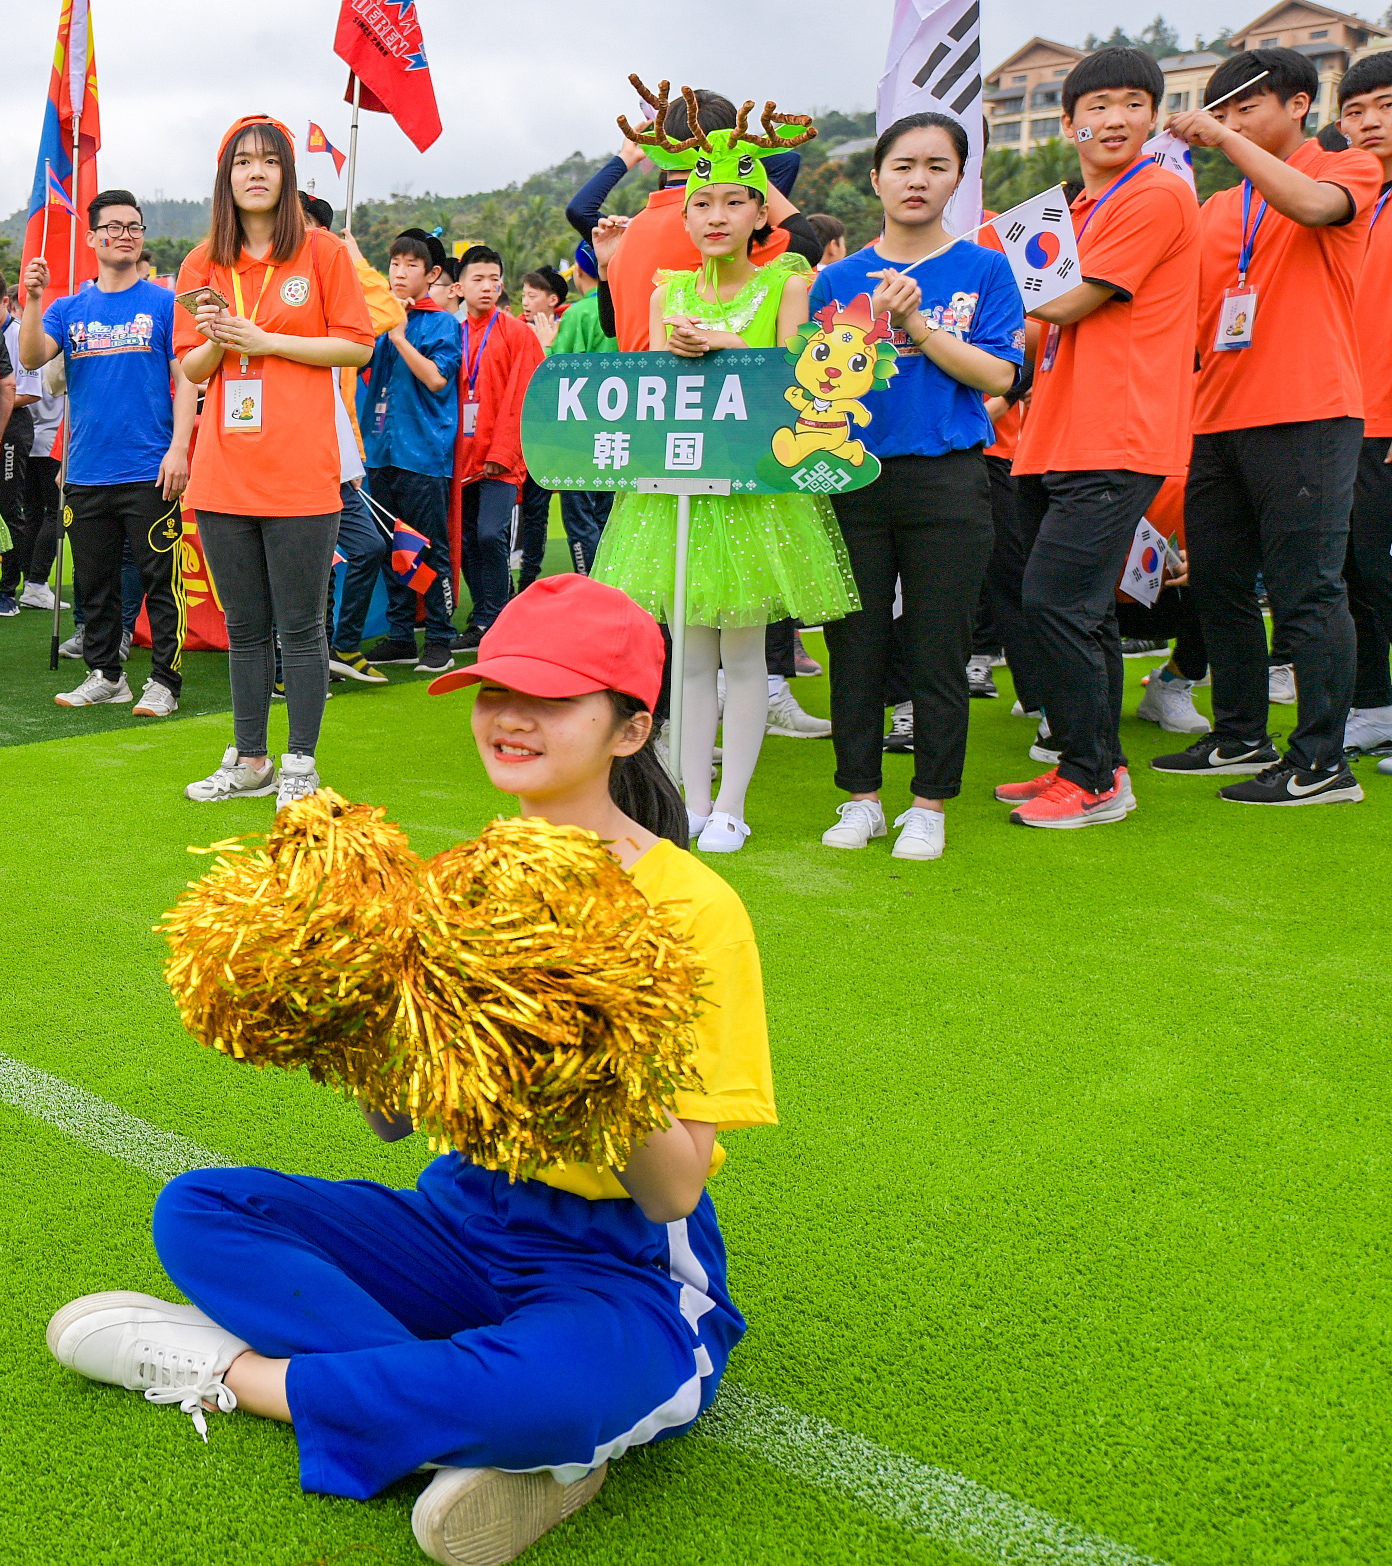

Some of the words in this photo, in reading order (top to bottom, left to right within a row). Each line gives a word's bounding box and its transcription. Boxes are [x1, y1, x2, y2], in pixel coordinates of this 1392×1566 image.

[557, 374, 748, 421] KOREA
[592, 431, 704, 471] 韩国
[573, 542, 587, 574] oma
